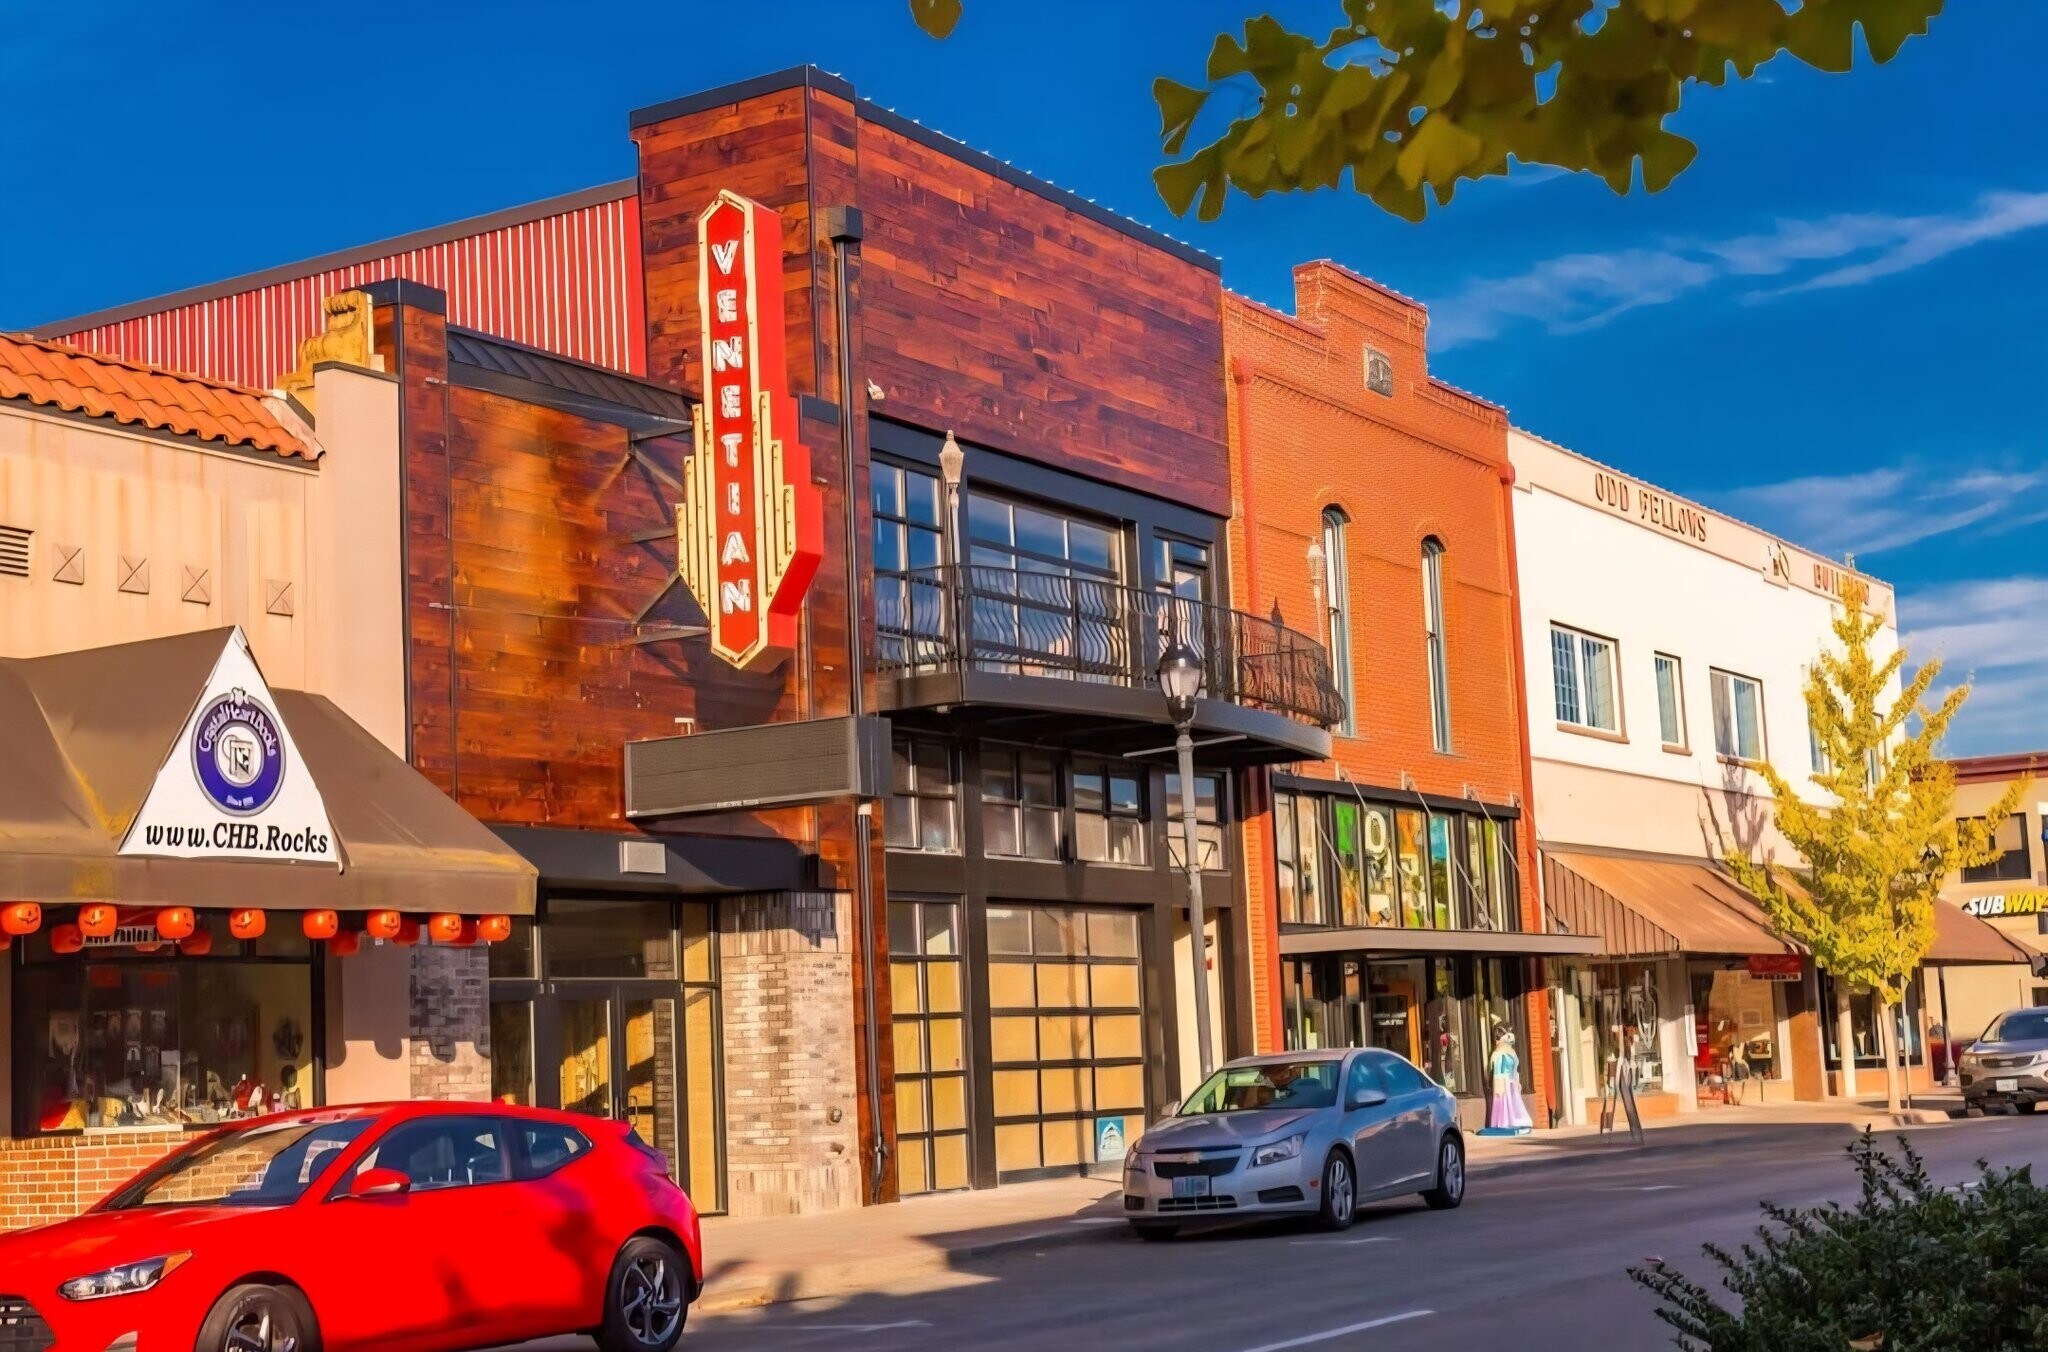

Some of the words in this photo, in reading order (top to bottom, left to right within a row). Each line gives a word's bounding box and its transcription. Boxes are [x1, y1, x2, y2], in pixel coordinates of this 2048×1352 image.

[712, 240, 751, 614] VENETIAN
[1595, 473, 1629, 512] ODD
[1639, 489, 1706, 542] FELLOWS
[146, 822, 328, 853] www.CHB.Rocks
[1965, 892, 2048, 915] SUBWAY
